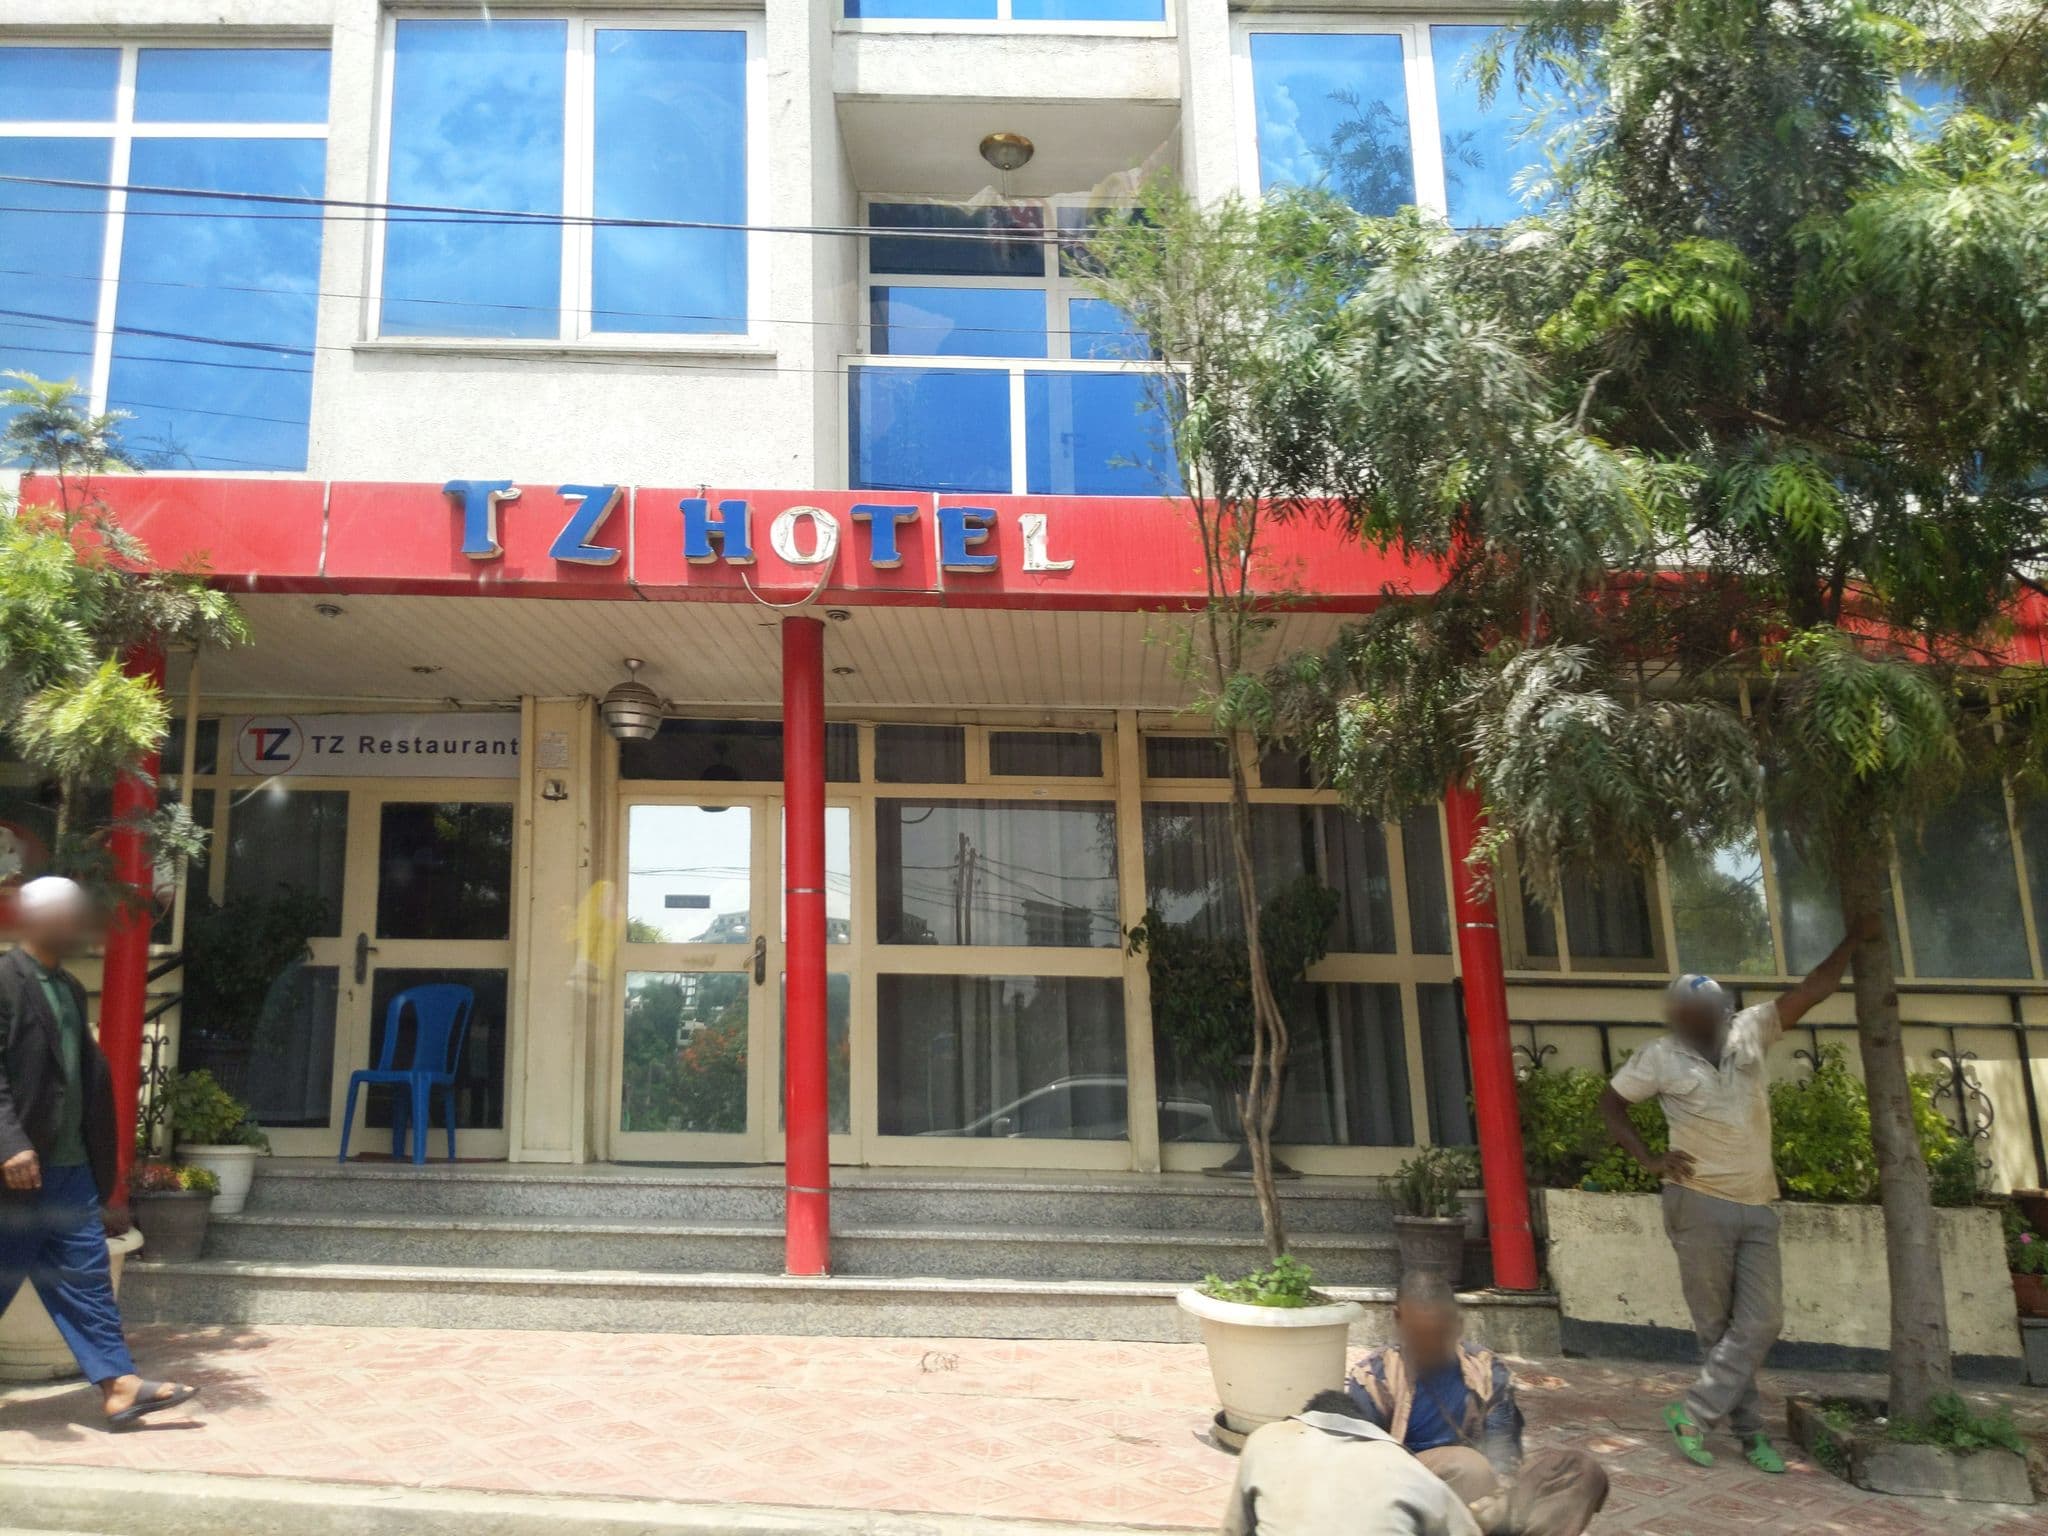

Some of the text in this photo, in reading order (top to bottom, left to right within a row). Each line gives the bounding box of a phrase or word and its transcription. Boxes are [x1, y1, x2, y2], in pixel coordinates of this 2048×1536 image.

[443, 480, 1075, 574] TZ HOTEL
[248, 728, 291, 760] TZ
[311, 735, 345, 754] TZ
[359, 735, 519, 756] Restaurant
